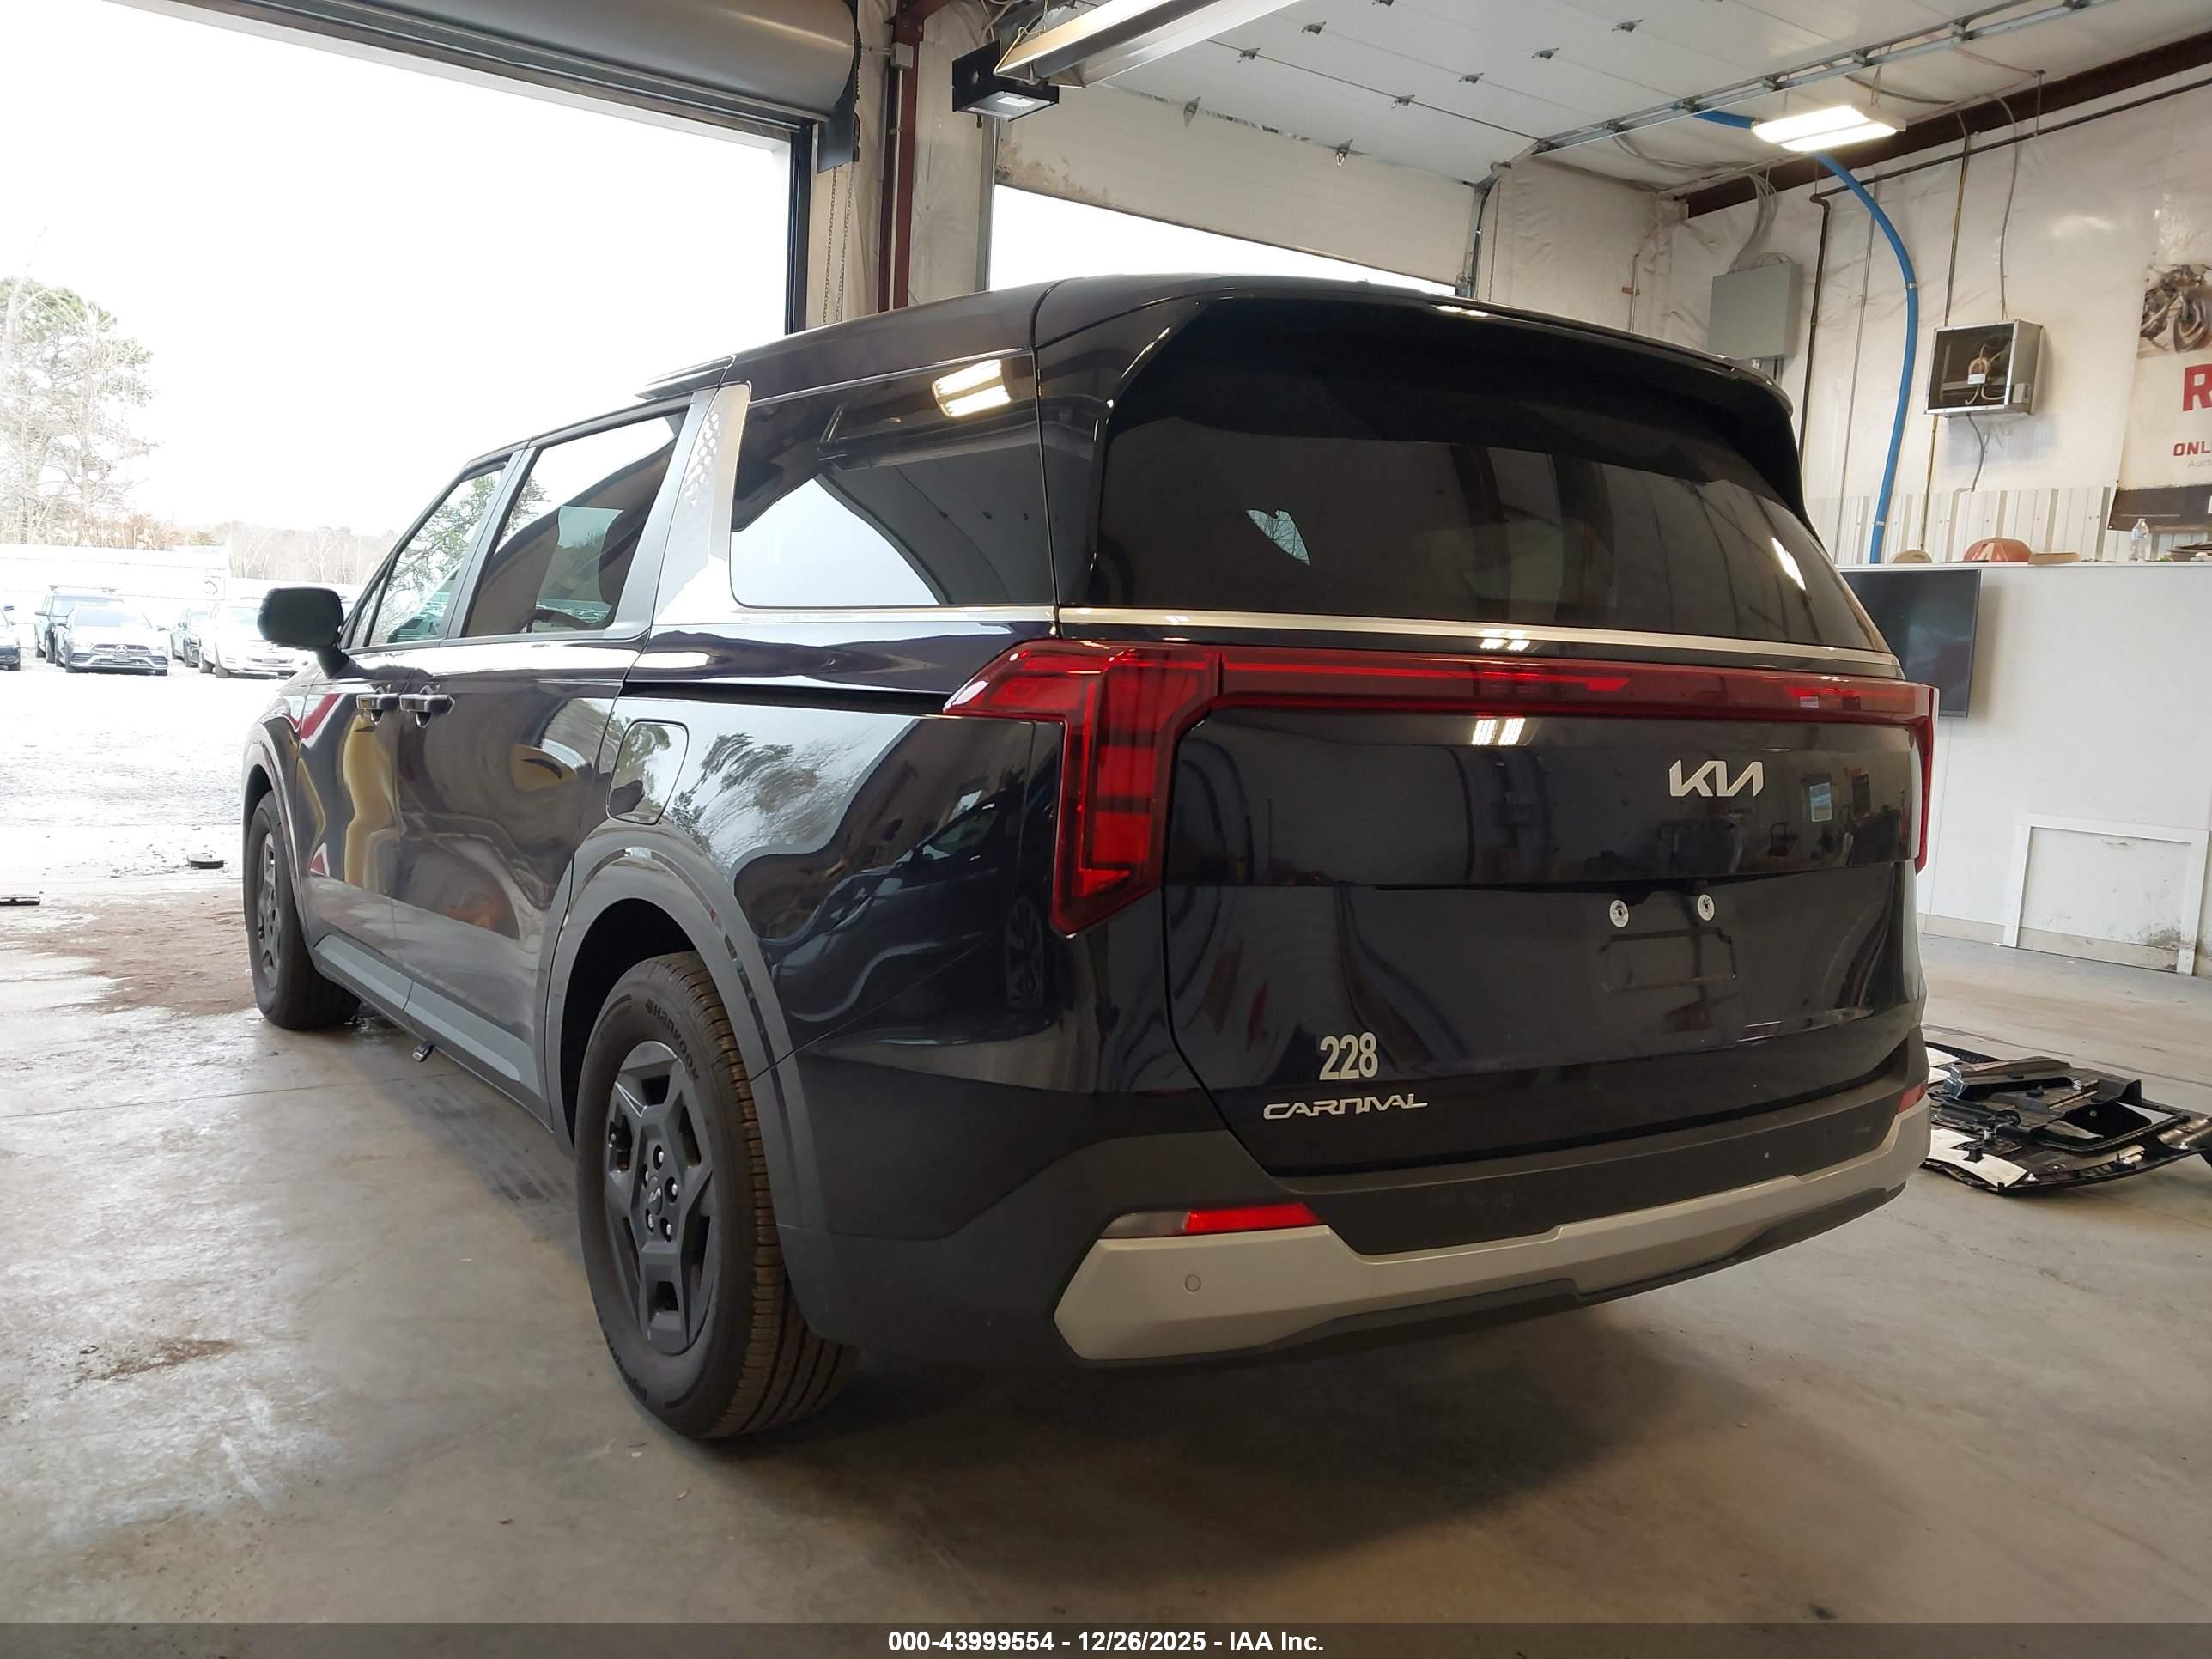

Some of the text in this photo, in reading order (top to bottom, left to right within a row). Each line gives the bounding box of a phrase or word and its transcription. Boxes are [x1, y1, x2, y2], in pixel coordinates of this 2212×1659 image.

[1669, 759, 1764, 797] KIA
[1319, 1032, 1378, 1080] 228
[1263, 1093, 1428, 1120] CARNIVAL
